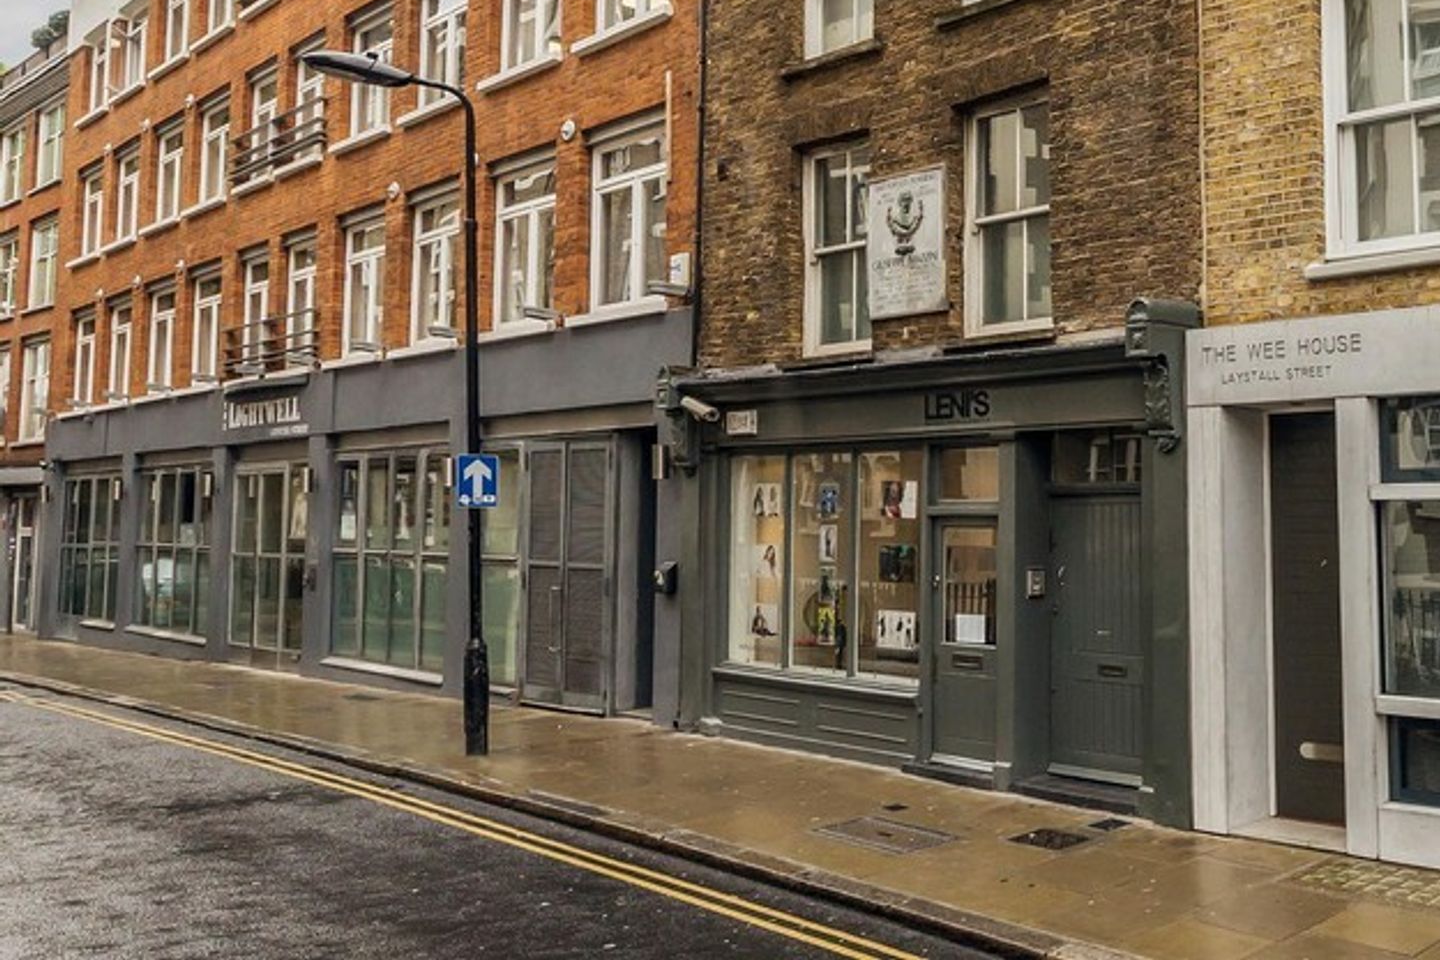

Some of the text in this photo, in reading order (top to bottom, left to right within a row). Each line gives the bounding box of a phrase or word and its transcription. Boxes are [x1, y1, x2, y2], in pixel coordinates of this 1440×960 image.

[1201, 332, 1362, 365] THE WEE HOUSE
[1221, 365, 1332, 385] LAYSTALL STREET
